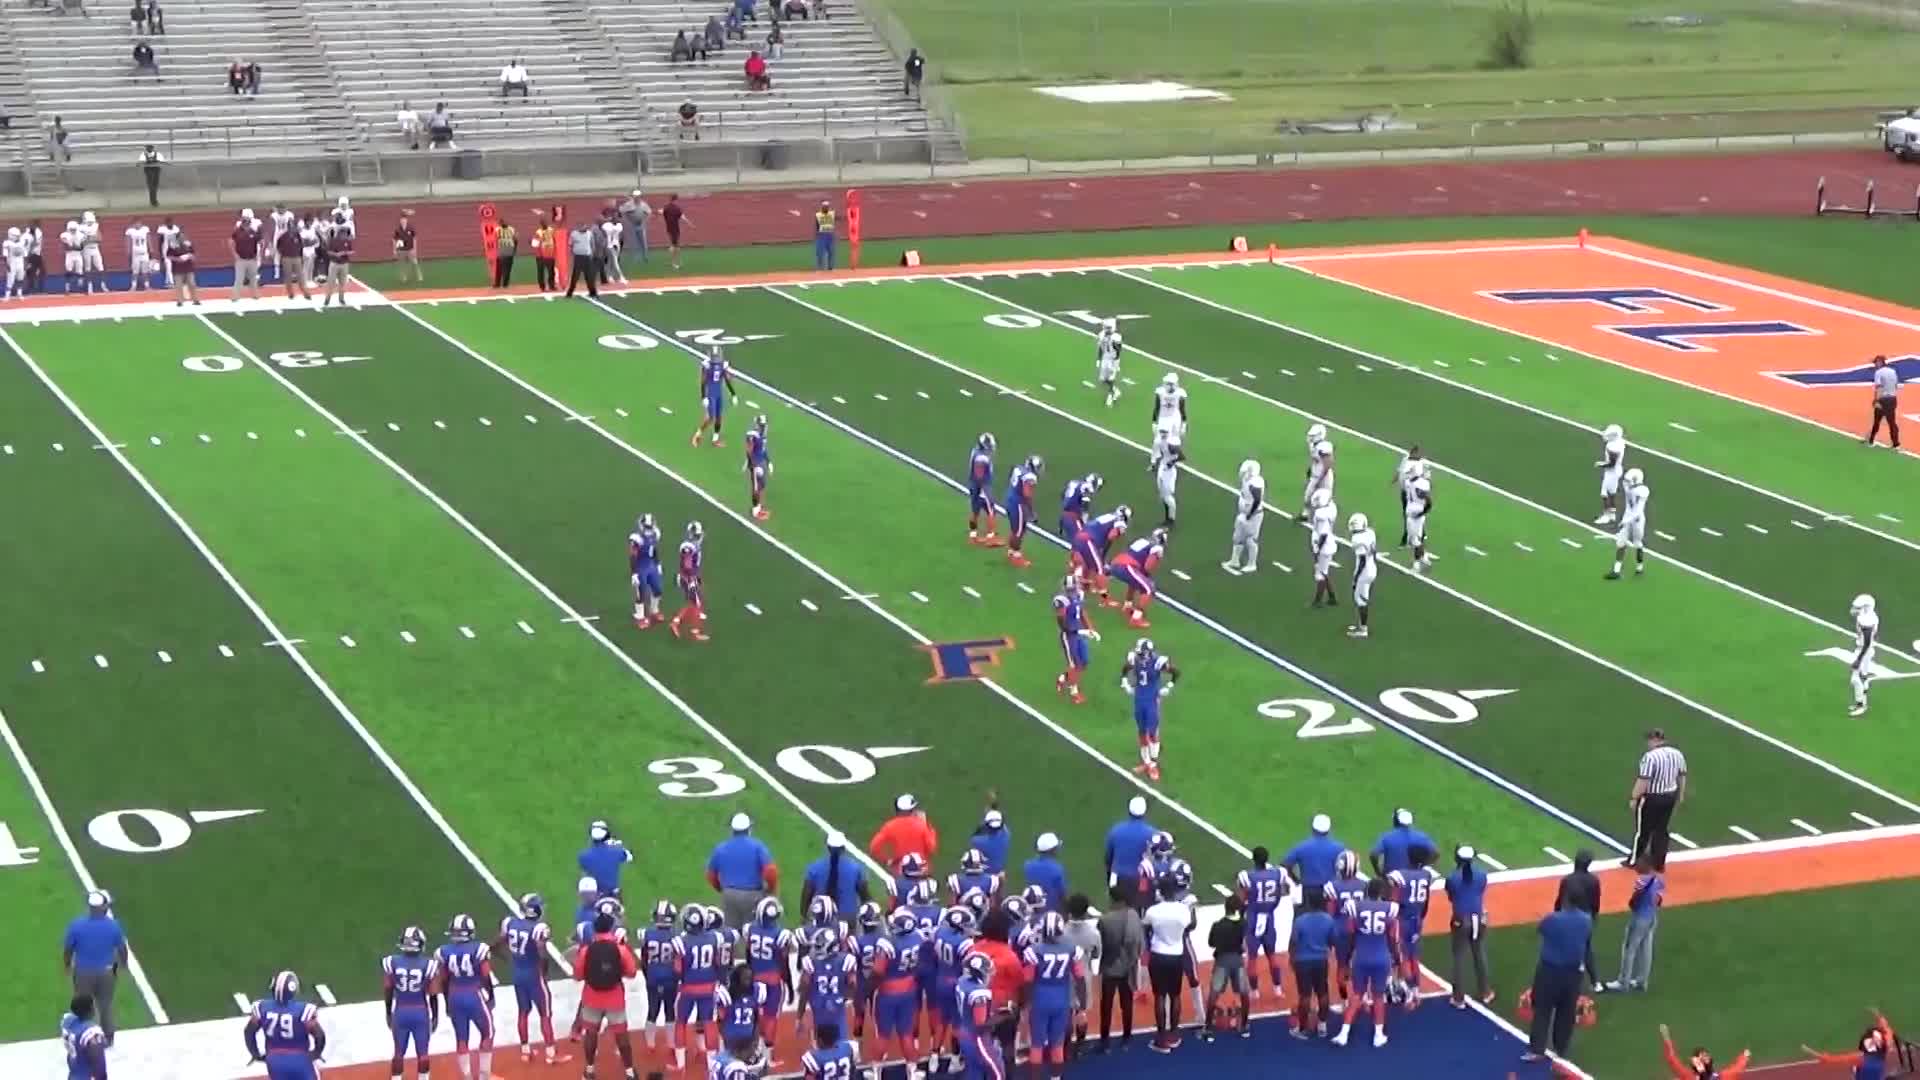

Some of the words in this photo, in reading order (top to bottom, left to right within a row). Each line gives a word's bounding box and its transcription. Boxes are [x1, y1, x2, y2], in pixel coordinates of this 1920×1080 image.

[1256, 880, 1276, 902] 12
[1409, 880, 1428, 902] 16
[1360, 910, 1386, 935] 36
[508, 928, 530, 955] 27
[647, 940, 673, 963] 28
[750, 934, 774, 960] 25
[447, 954, 473, 978] 44
[691, 943, 713, 968] 10
[1042, 953, 1069, 978] 77
[395, 968, 422, 993] 32
[266, 1012, 294, 1040] 79
